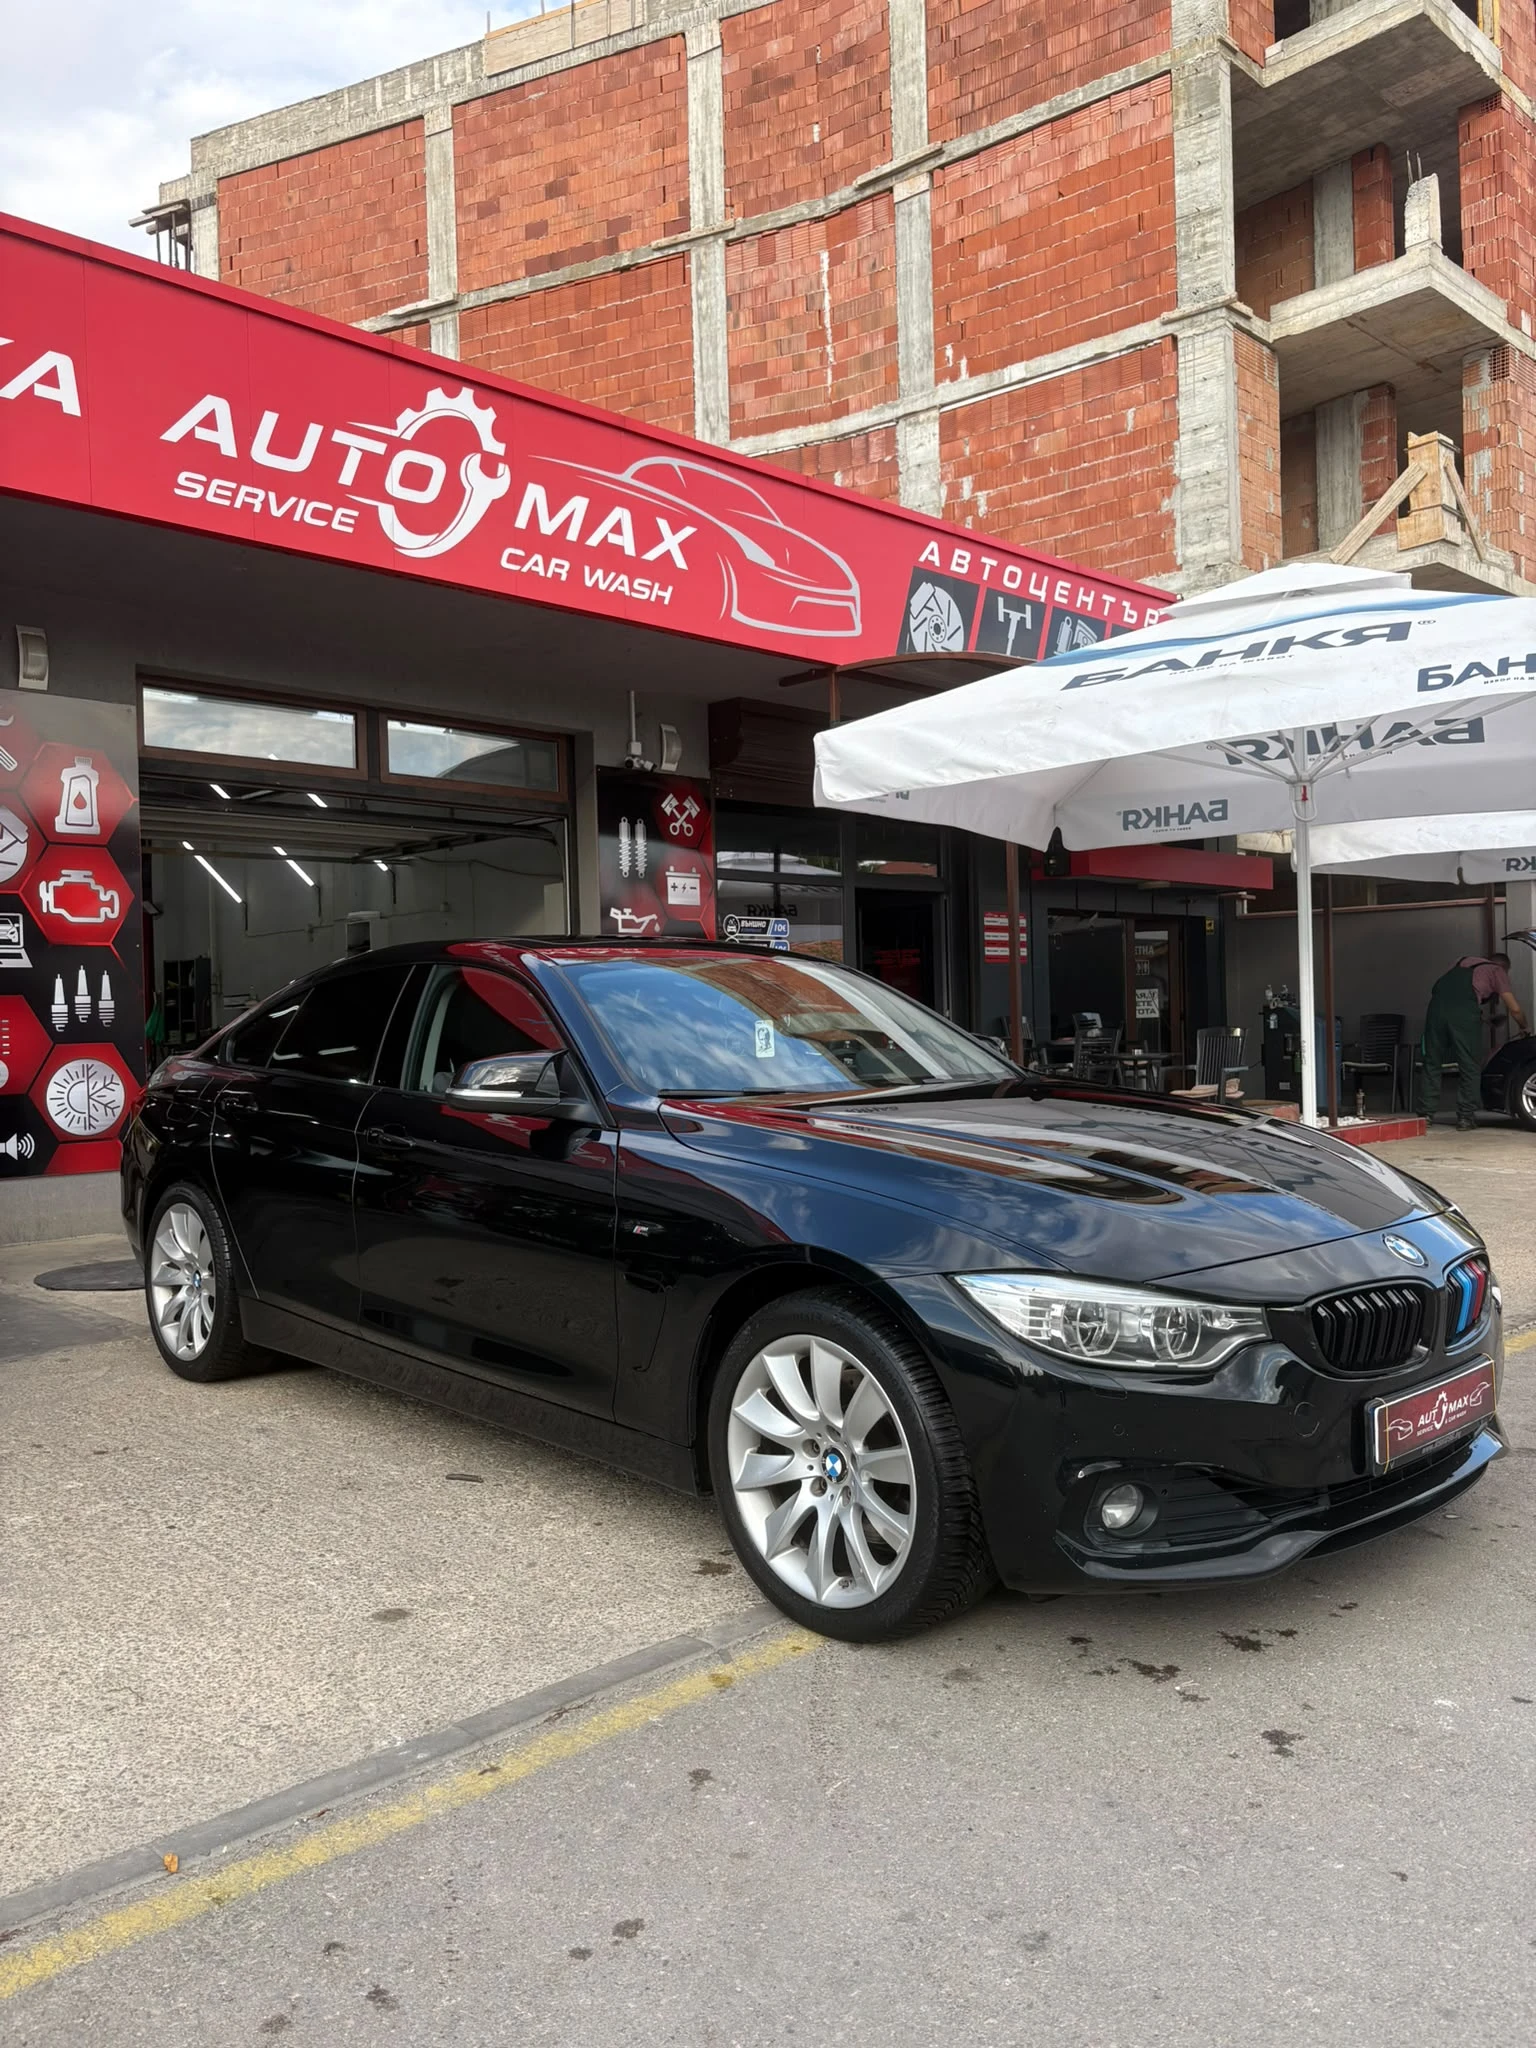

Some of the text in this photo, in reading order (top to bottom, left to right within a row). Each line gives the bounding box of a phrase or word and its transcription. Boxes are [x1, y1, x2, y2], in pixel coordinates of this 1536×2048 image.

[0, 337, 81, 417] А
[159, 394, 698, 571] AUTO MAX
[173, 471, 673, 605] SERVICE CAR WASH
[919, 541, 1159, 627] АВТОЦЕНТЪР
[1060, 621, 1412, 691] БАНКЯ
[1449, 1395, 1469, 1413] MAX
